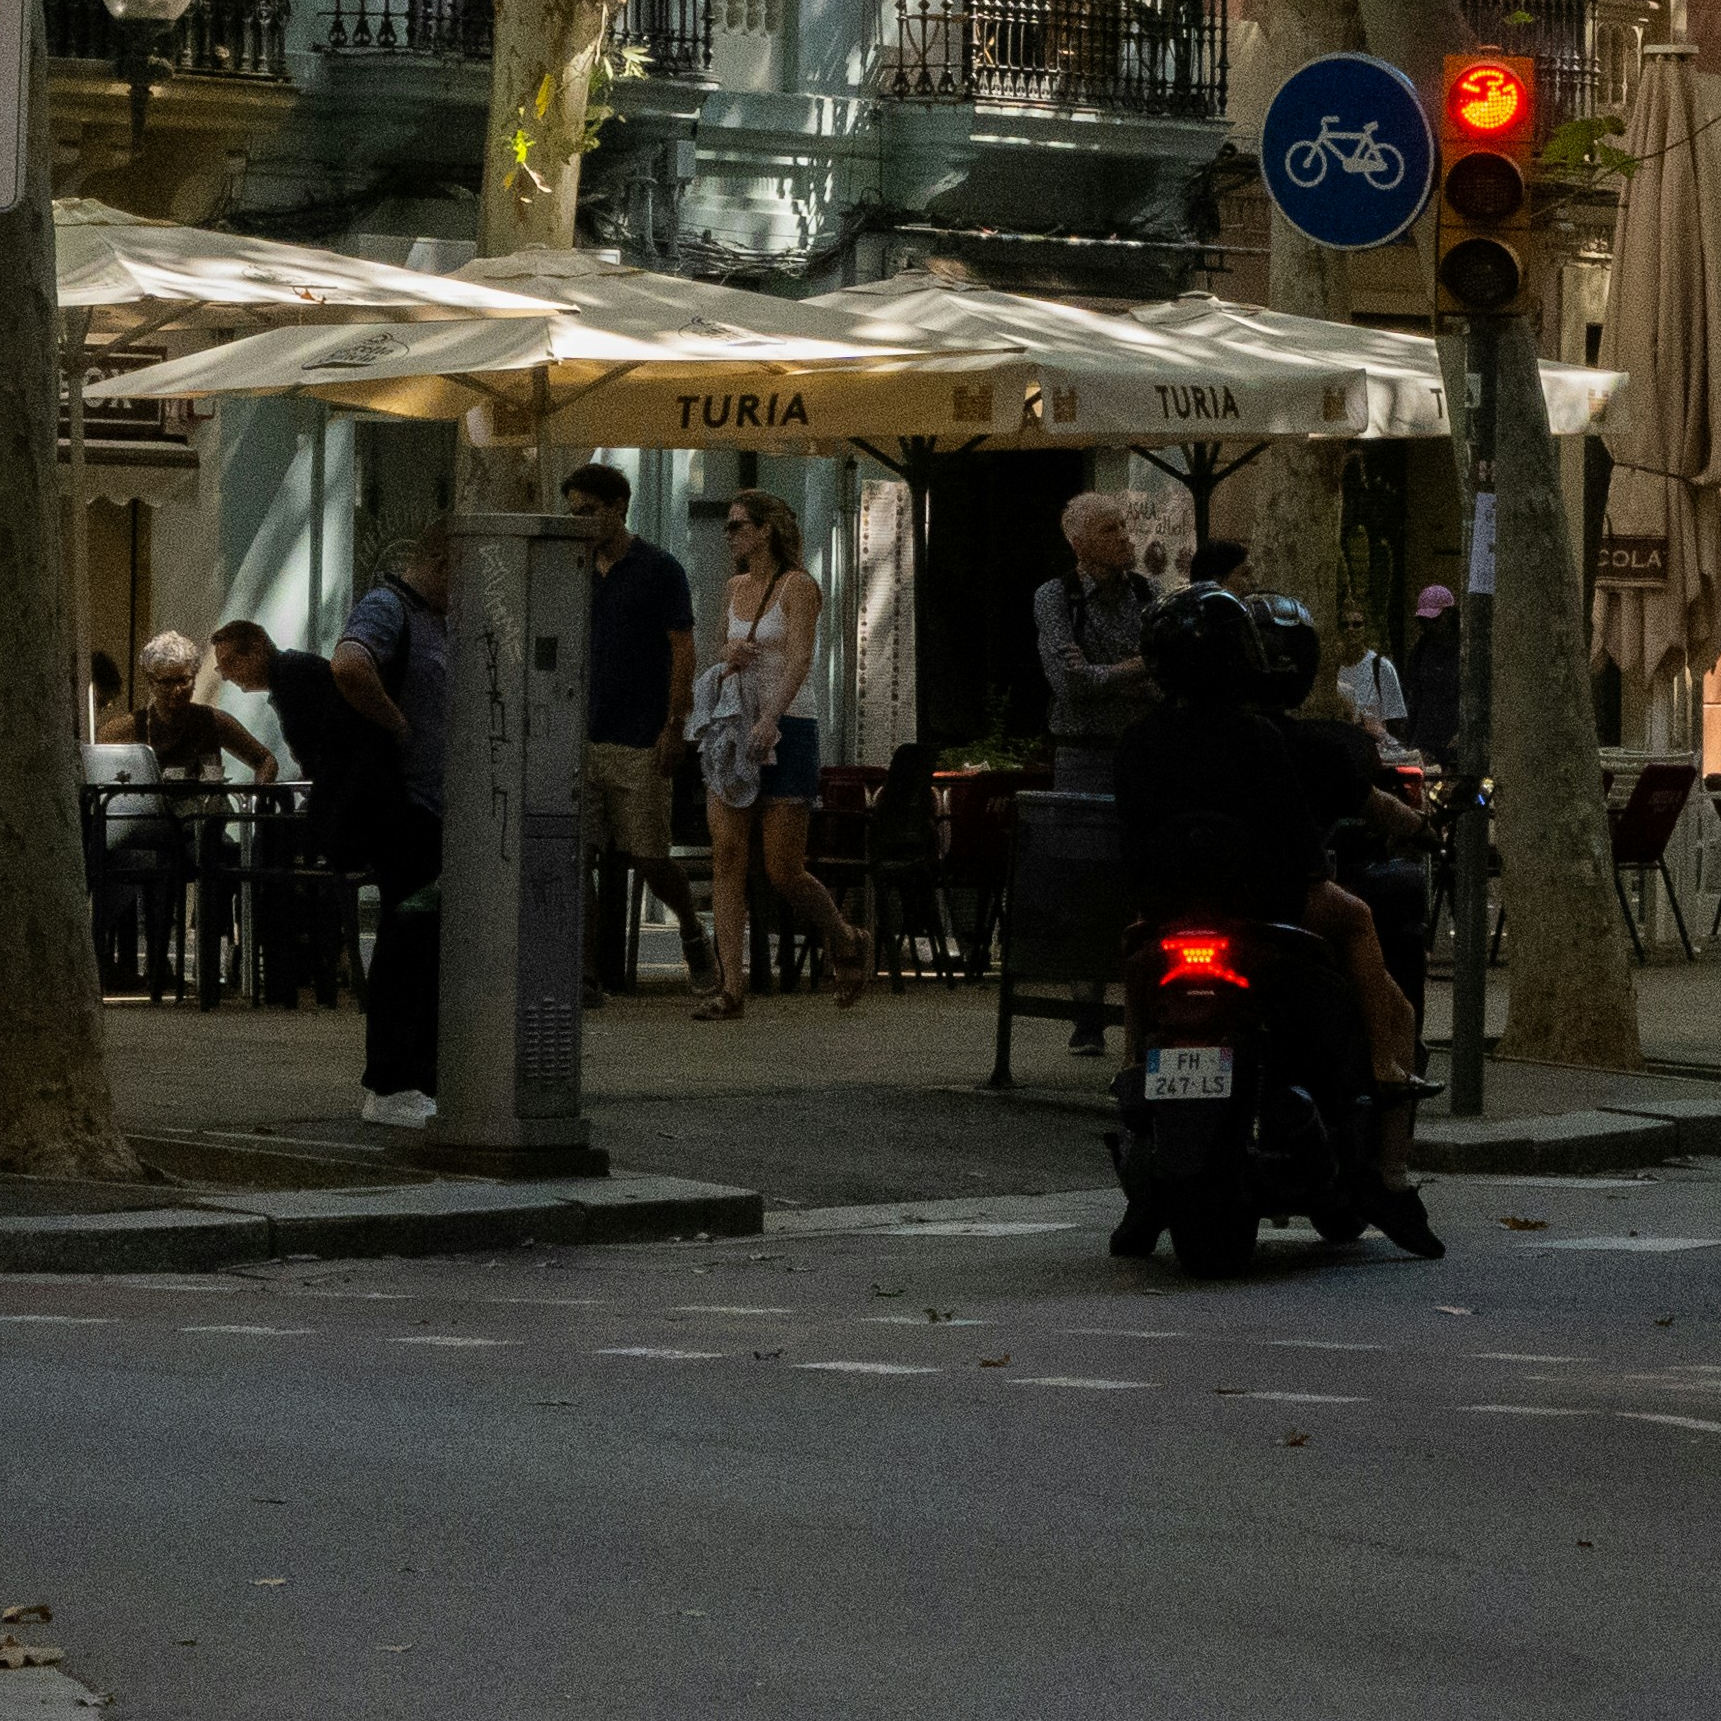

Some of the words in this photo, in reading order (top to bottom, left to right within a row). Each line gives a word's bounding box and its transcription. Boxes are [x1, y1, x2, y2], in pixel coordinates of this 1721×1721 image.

[676, 391, 809, 429] TURIA
[1155, 384, 1240, 419] TURIA
[1177, 1053, 1201, 1070] FH
